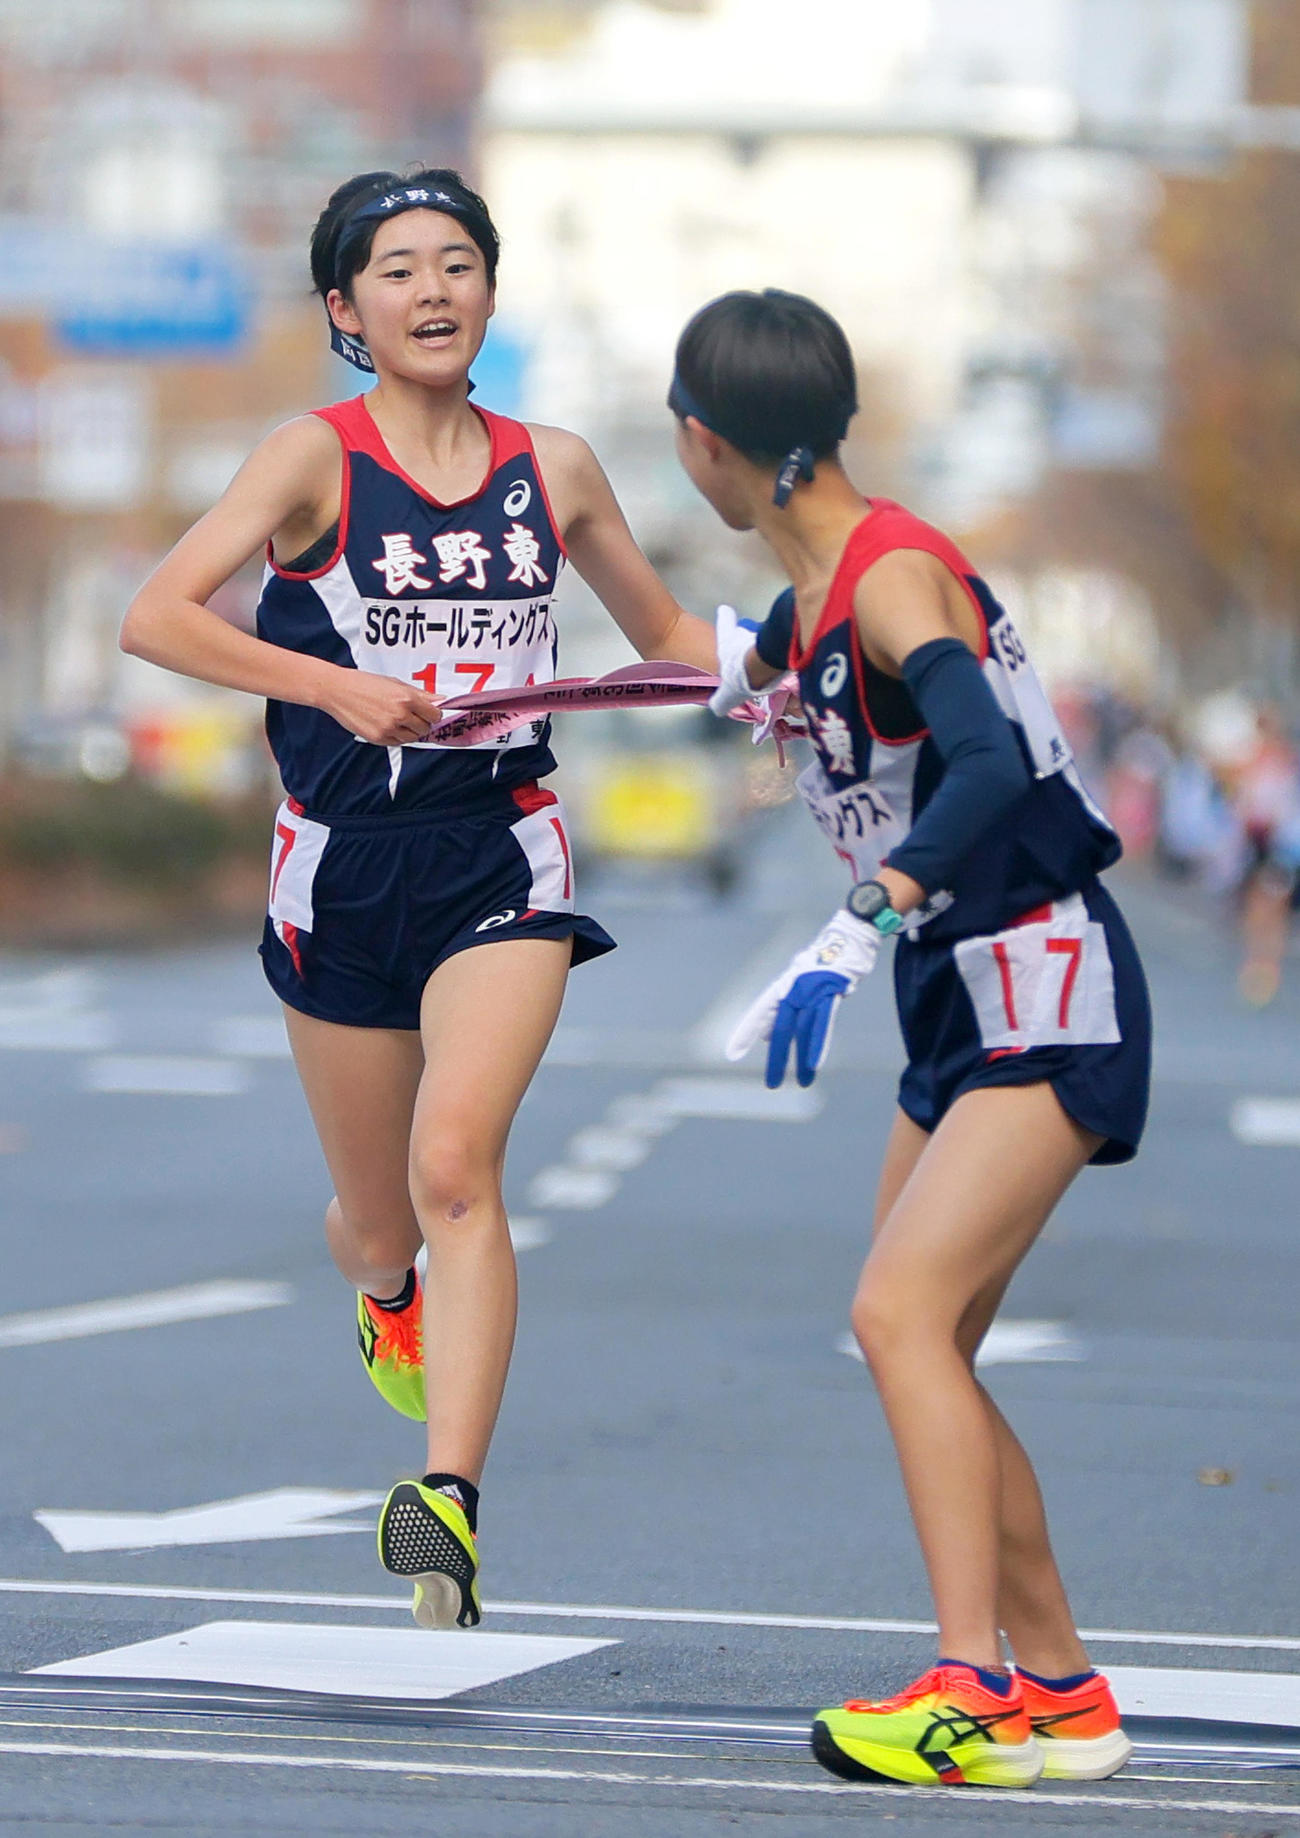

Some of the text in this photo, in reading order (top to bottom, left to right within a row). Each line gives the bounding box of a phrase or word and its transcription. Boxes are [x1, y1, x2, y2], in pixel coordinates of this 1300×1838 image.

[373, 523, 549, 596] 長野東
[365, 603, 550, 650] SGホールディングス
[273, 822, 297, 904] 7
[992, 938, 1083, 1031] 17
